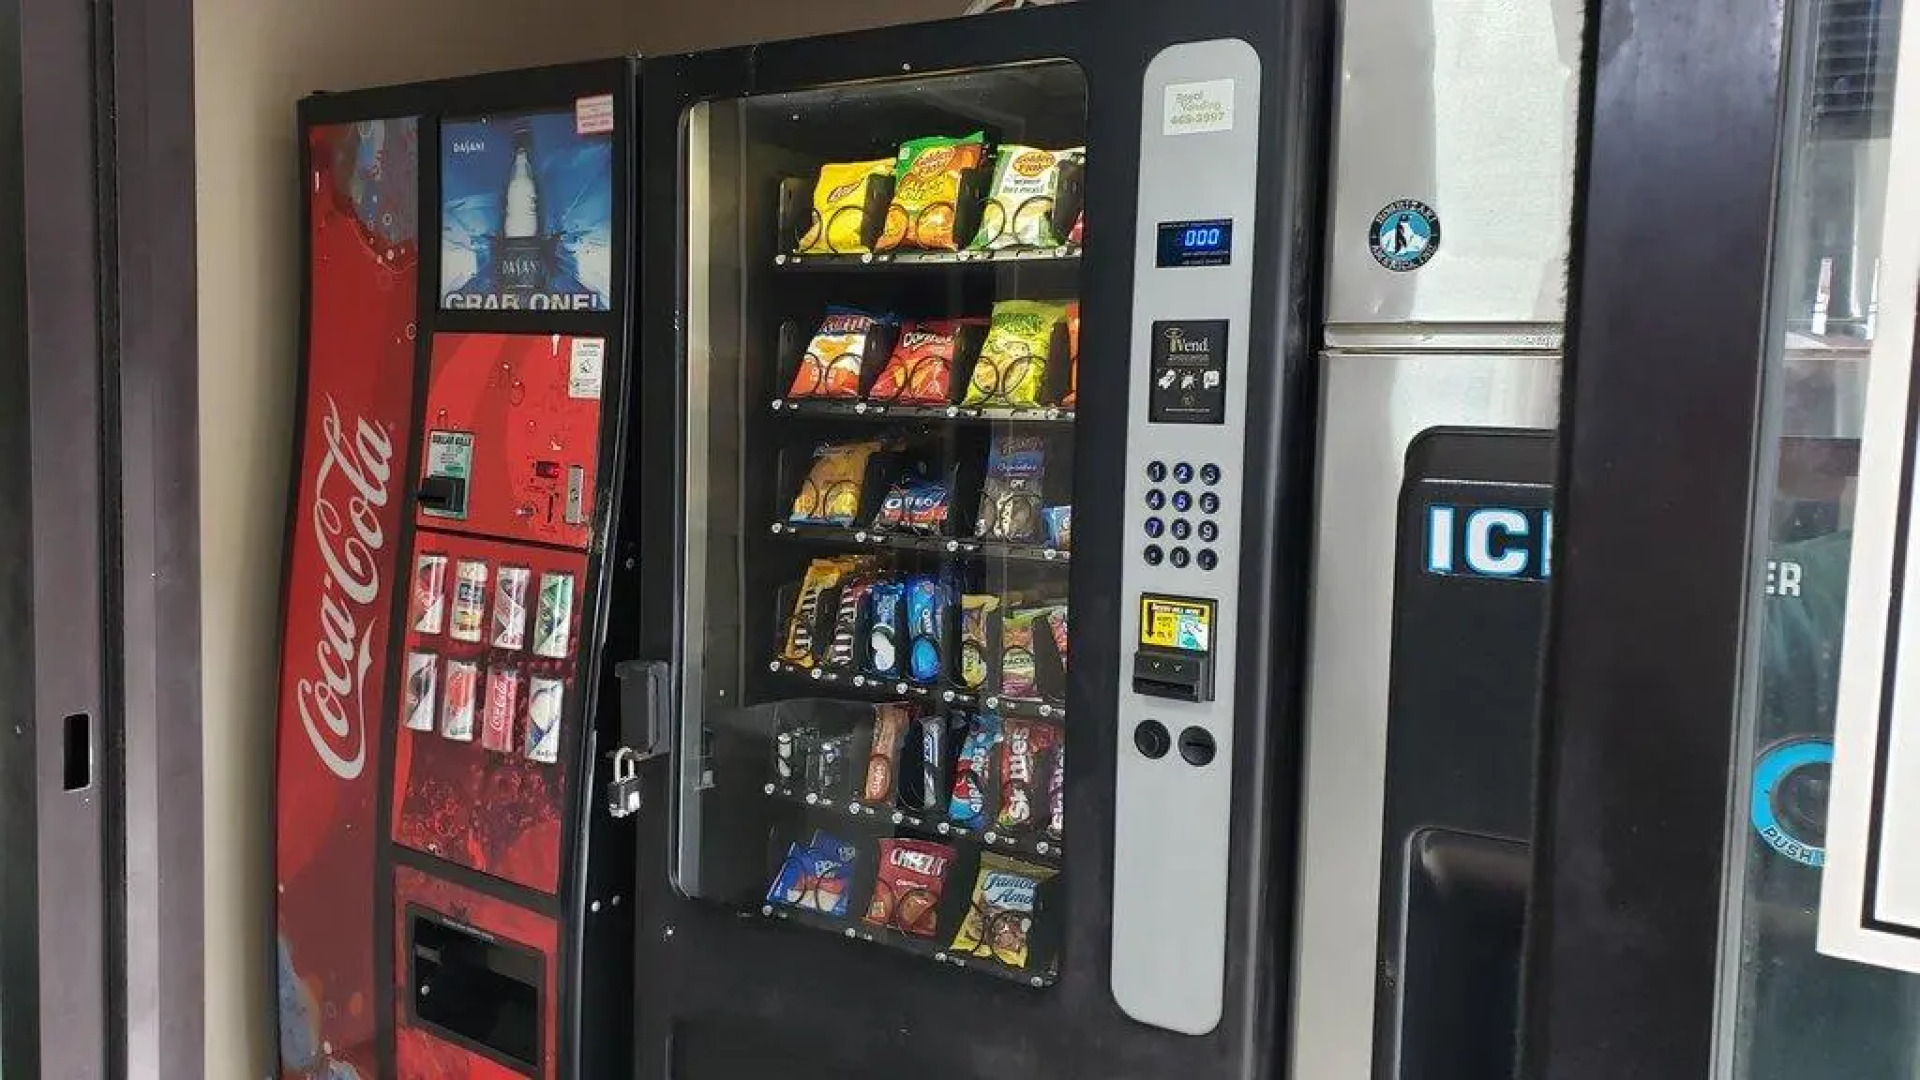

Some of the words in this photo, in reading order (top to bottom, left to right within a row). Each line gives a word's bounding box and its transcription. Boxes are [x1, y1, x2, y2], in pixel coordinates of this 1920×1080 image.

[1178, 466, 1187, 479] 2
[1151, 493, 1160, 507] 4
[1204, 525, 1212, 539] 9
[1428, 505, 1552, 578] IC
[1176, 551, 1184, 564] 0
[299, 391, 392, 780] Coca-Cola
[991, 889, 1035, 904] Amo
